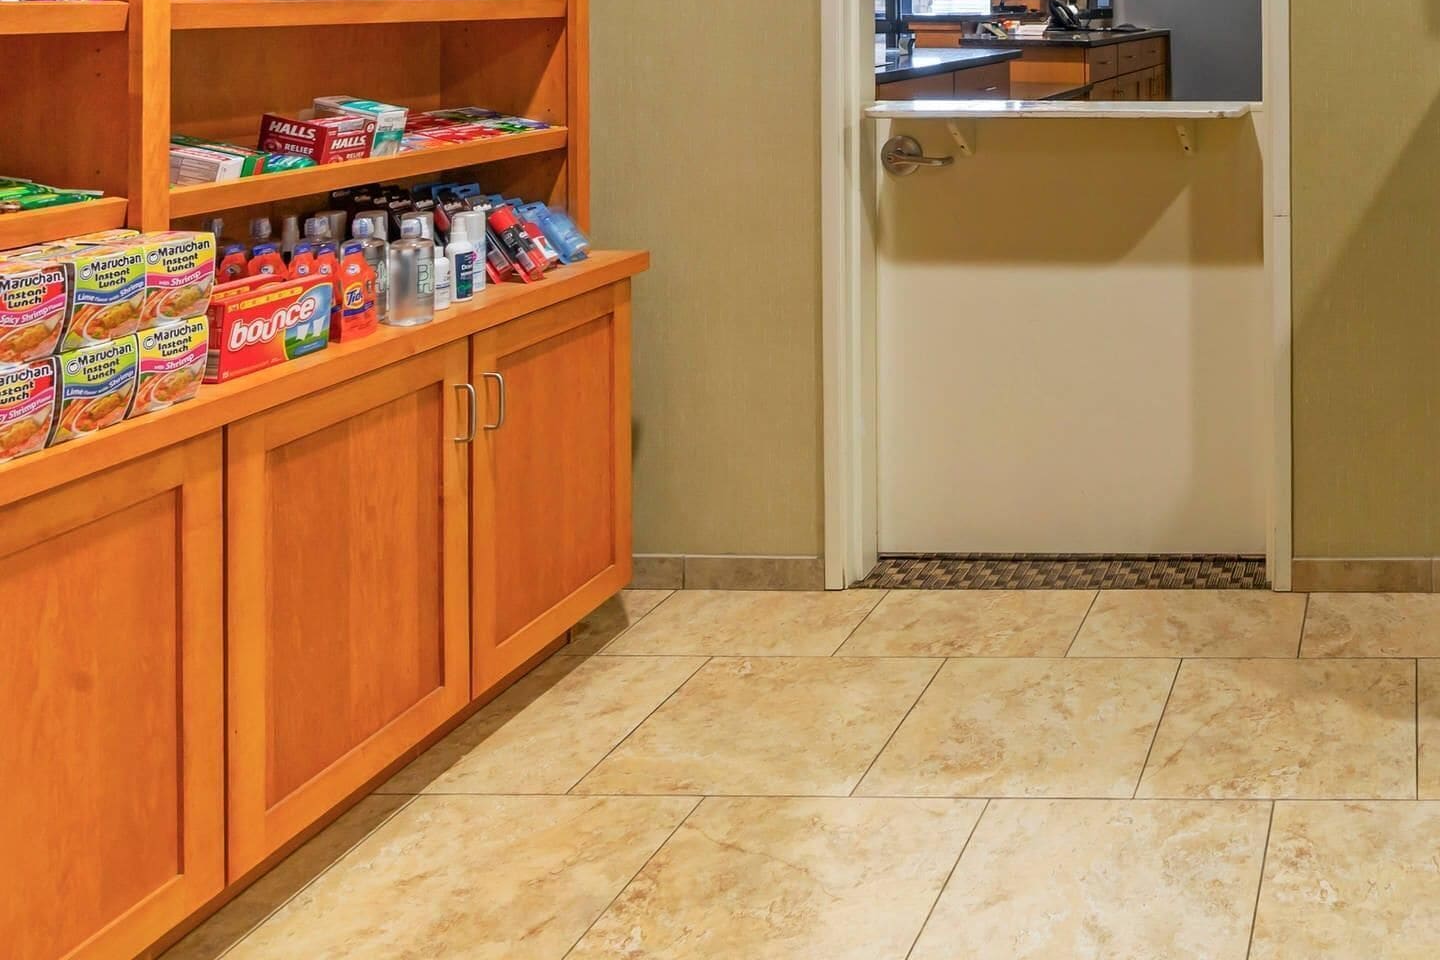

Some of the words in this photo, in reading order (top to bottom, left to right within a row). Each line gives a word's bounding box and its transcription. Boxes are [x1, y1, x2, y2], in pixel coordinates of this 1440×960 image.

[284, 143, 313, 155] RELIEF
[331, 135, 366, 150] HALLS
[158, 240, 210, 257] Maruchan
[90, 254, 142, 272] Maruchan
[163, 253, 198, 267] Instant
[167, 261, 195, 272] Lunch
[0, 272, 61, 291] Maruchan
[95, 267, 130, 281] Instant
[170, 271, 201, 286] Shrimp
[99, 278, 126, 289] Lunch
[4, 287, 46, 302] Instant
[8, 297, 42, 309] Lunch
[22, 307, 49, 323] Shrimp
[154, 323, 203, 341] Maruchan
[228, 297, 316, 352] bounce
[158, 336, 192, 350] Instant
[162, 344, 188, 357] Lunch
[78, 344, 131, 365] Maruchan
[83, 358, 120, 375] Instant
[88, 368, 115, 381] Lunch
